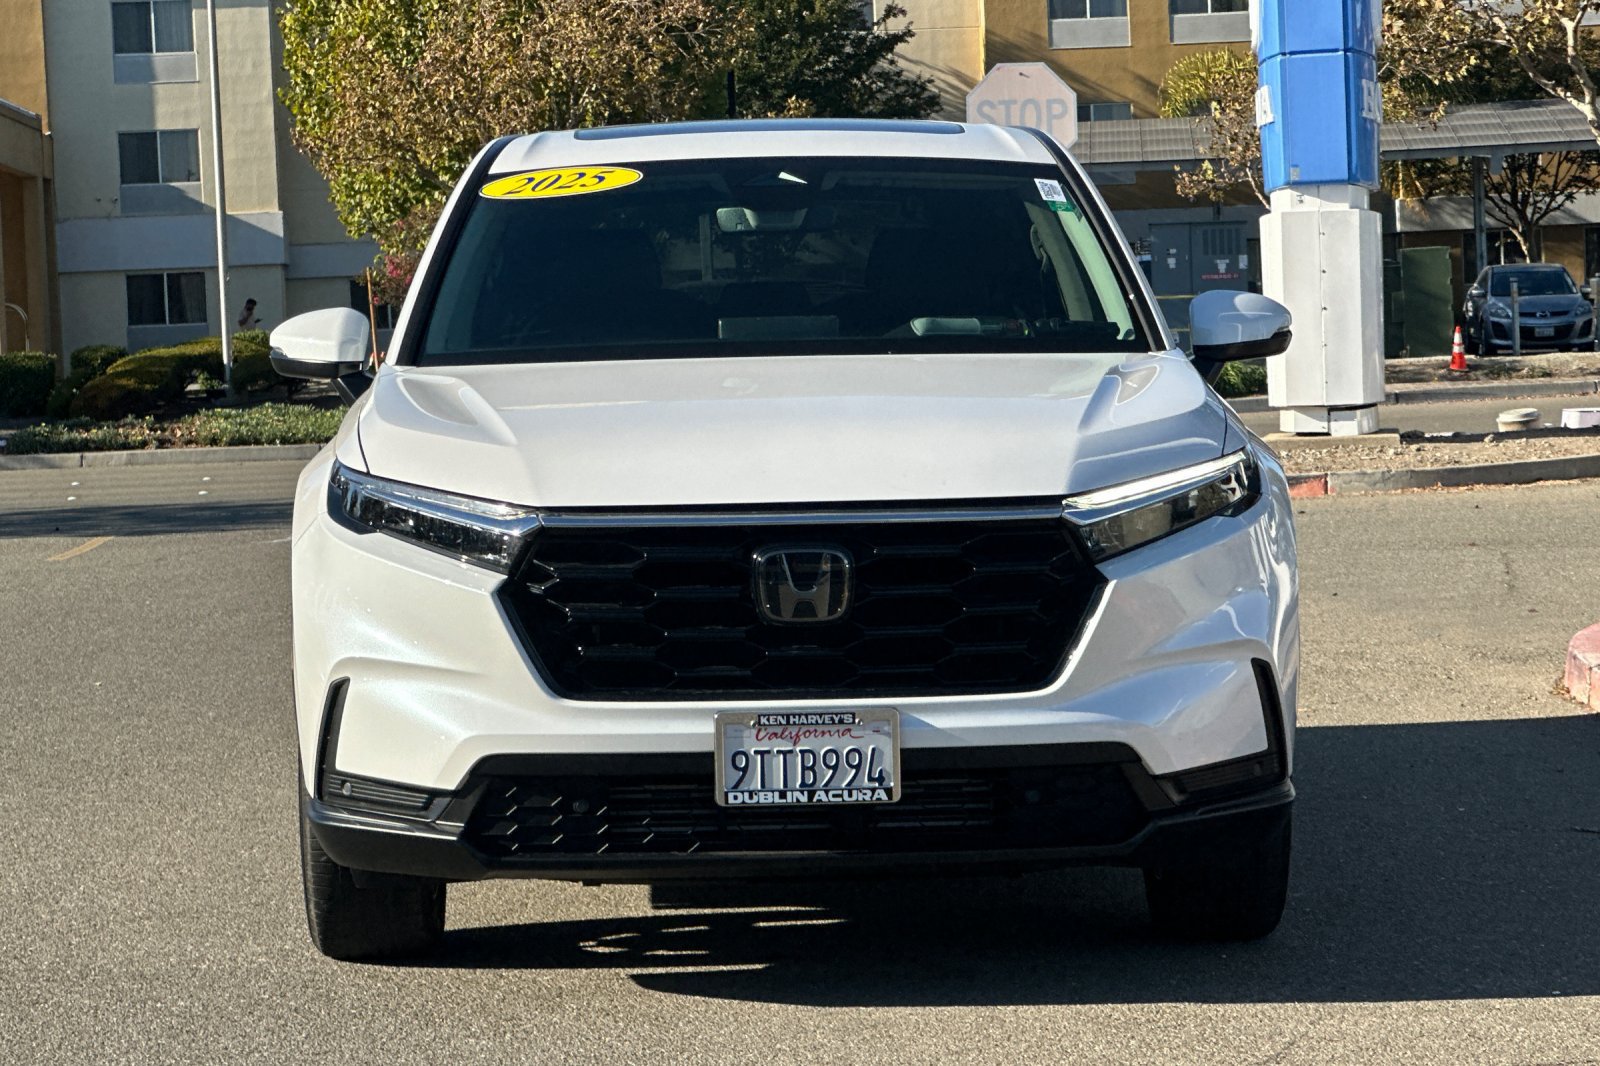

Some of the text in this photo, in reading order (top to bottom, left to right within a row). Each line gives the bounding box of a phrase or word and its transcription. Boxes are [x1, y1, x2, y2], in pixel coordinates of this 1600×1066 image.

[976, 98, 1068, 136] STOP
[501, 170, 616, 196] 2025
[760, 713, 853, 725] KEN HARVEY'S
[755, 727, 864, 746] California
[730, 746, 886, 790] 9TTB994
[728, 789, 889, 804] DUBLIN ACURA
